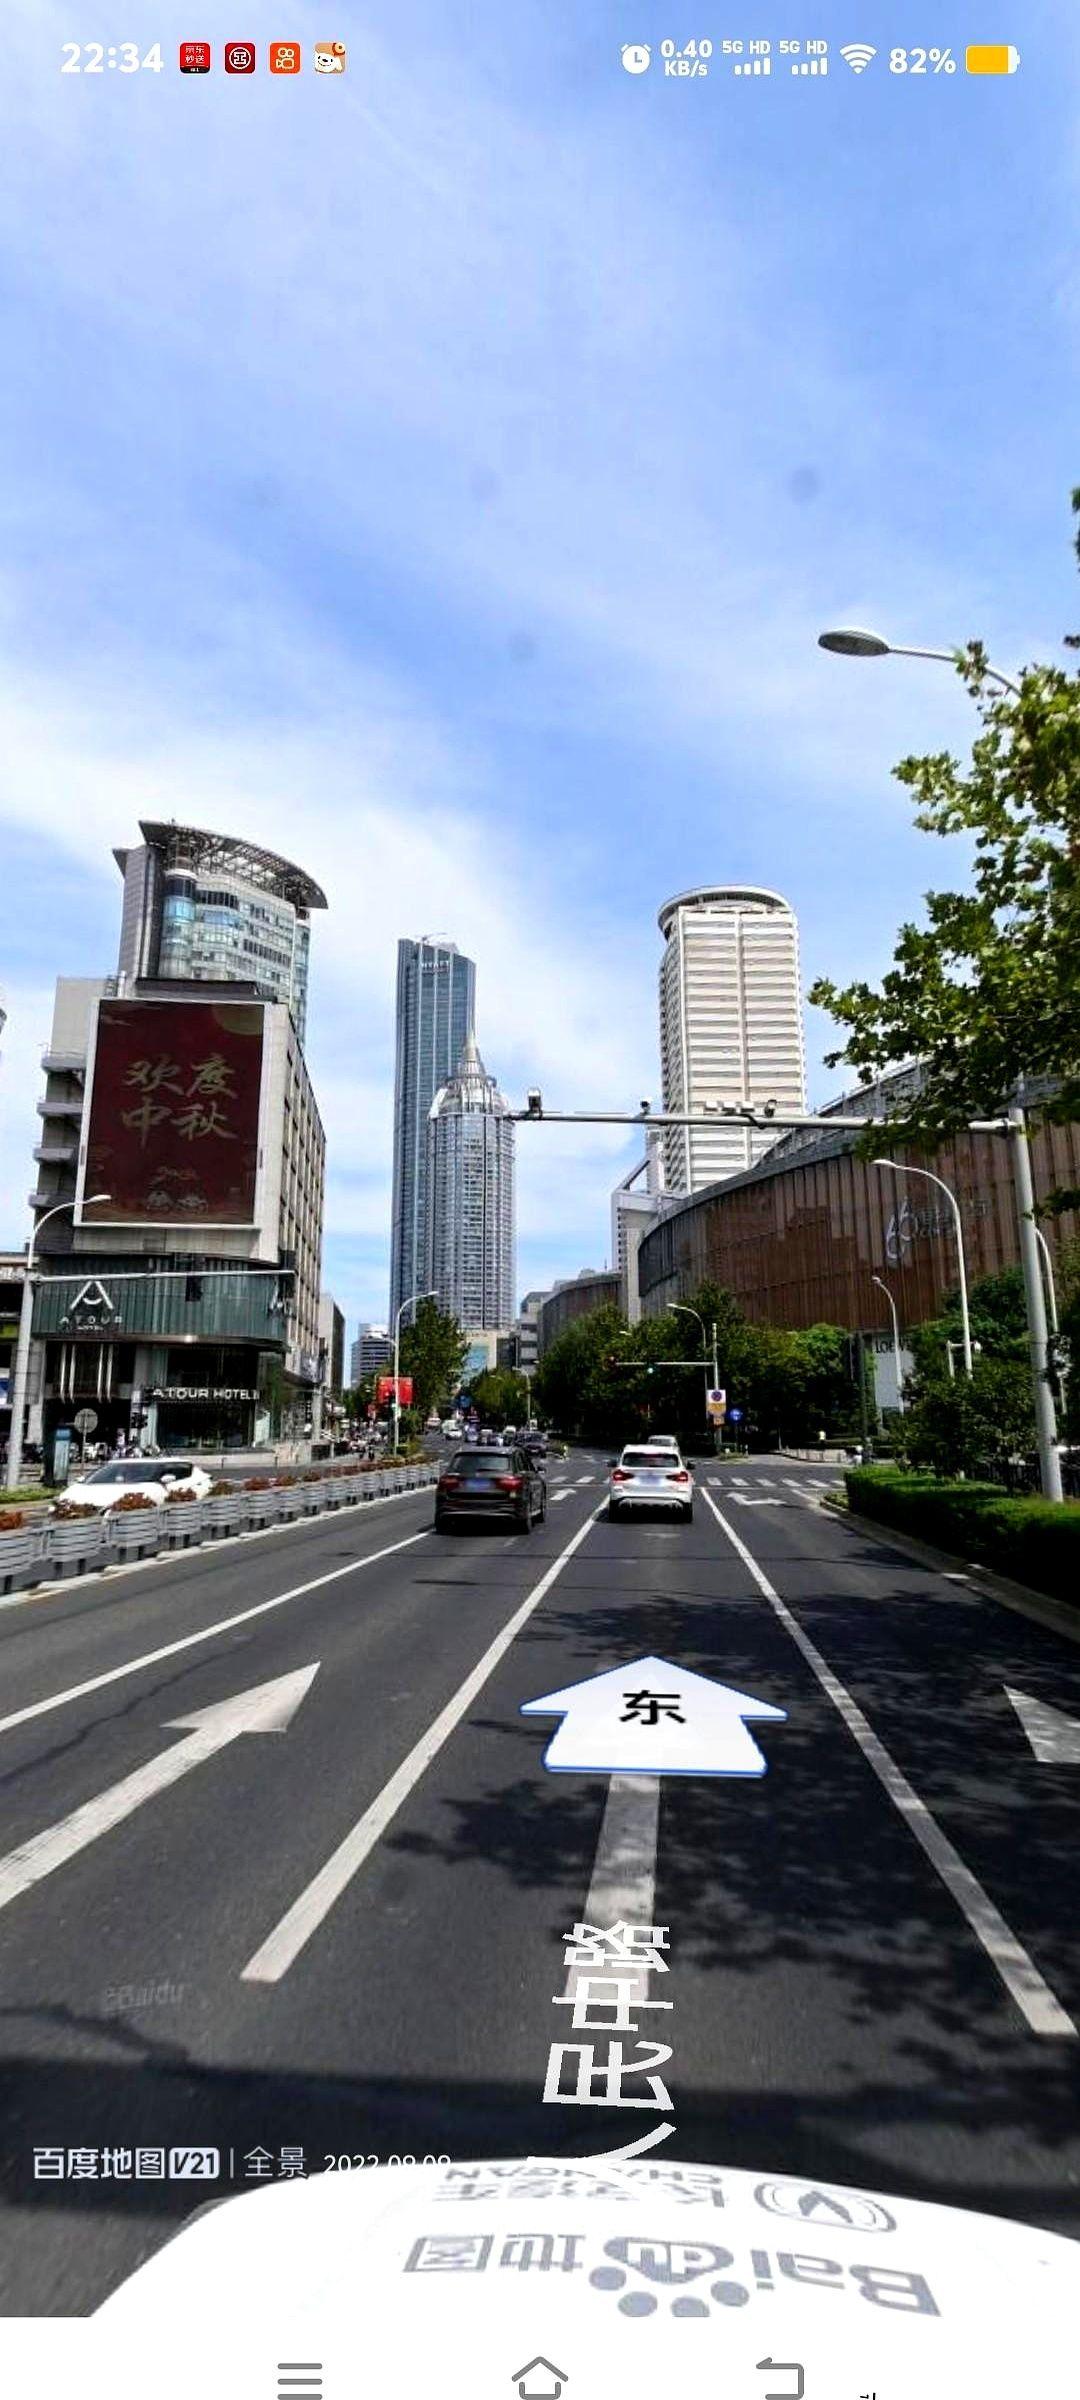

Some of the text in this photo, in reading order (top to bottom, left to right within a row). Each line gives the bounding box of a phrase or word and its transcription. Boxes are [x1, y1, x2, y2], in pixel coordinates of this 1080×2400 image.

[124, 1053, 238, 1098] 欢度
[121, 1098, 238, 1147] 中秋
[153, 1387, 208, 1399] ATOUR
[213, 1389, 251, 1400] HOTEL
